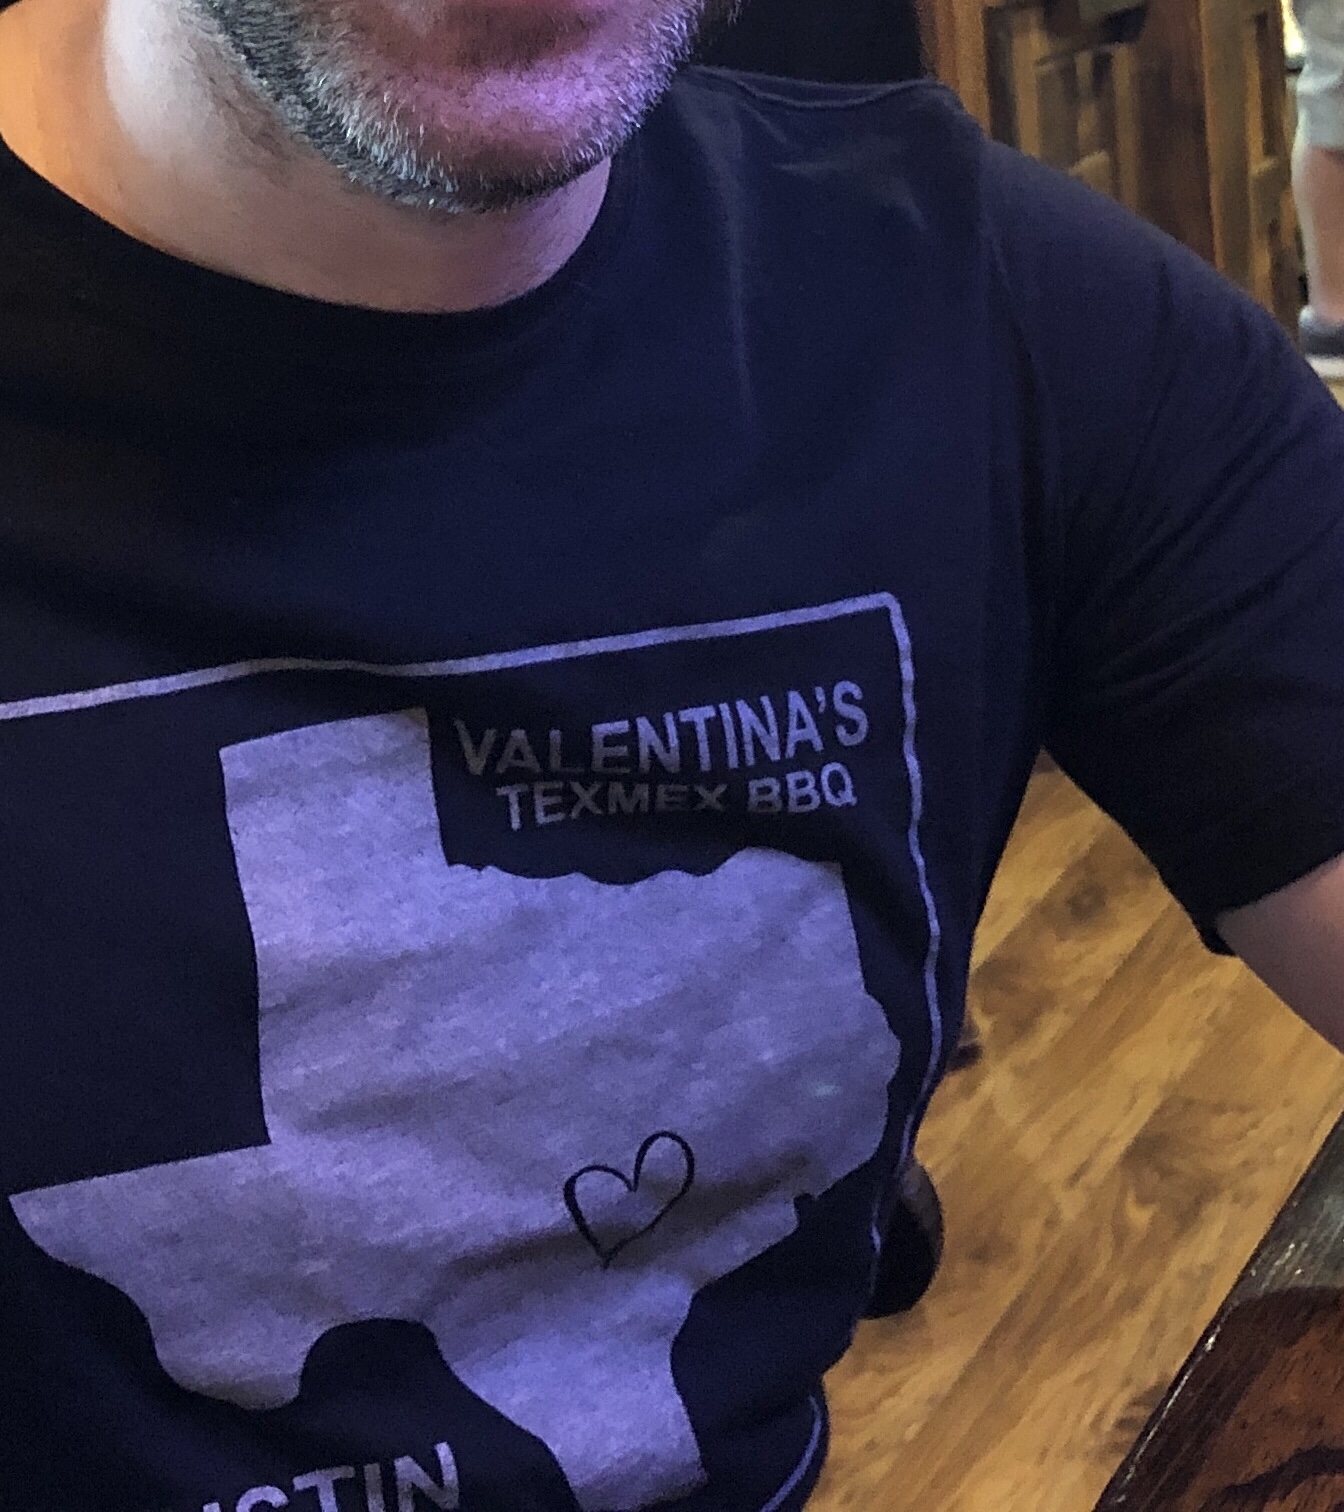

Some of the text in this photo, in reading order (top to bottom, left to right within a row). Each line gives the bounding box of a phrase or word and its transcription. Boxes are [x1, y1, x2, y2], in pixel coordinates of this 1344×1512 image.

[454, 679, 869, 776] VALENTINA'S
[496, 761, 858, 832] TEXMEX BBQ
